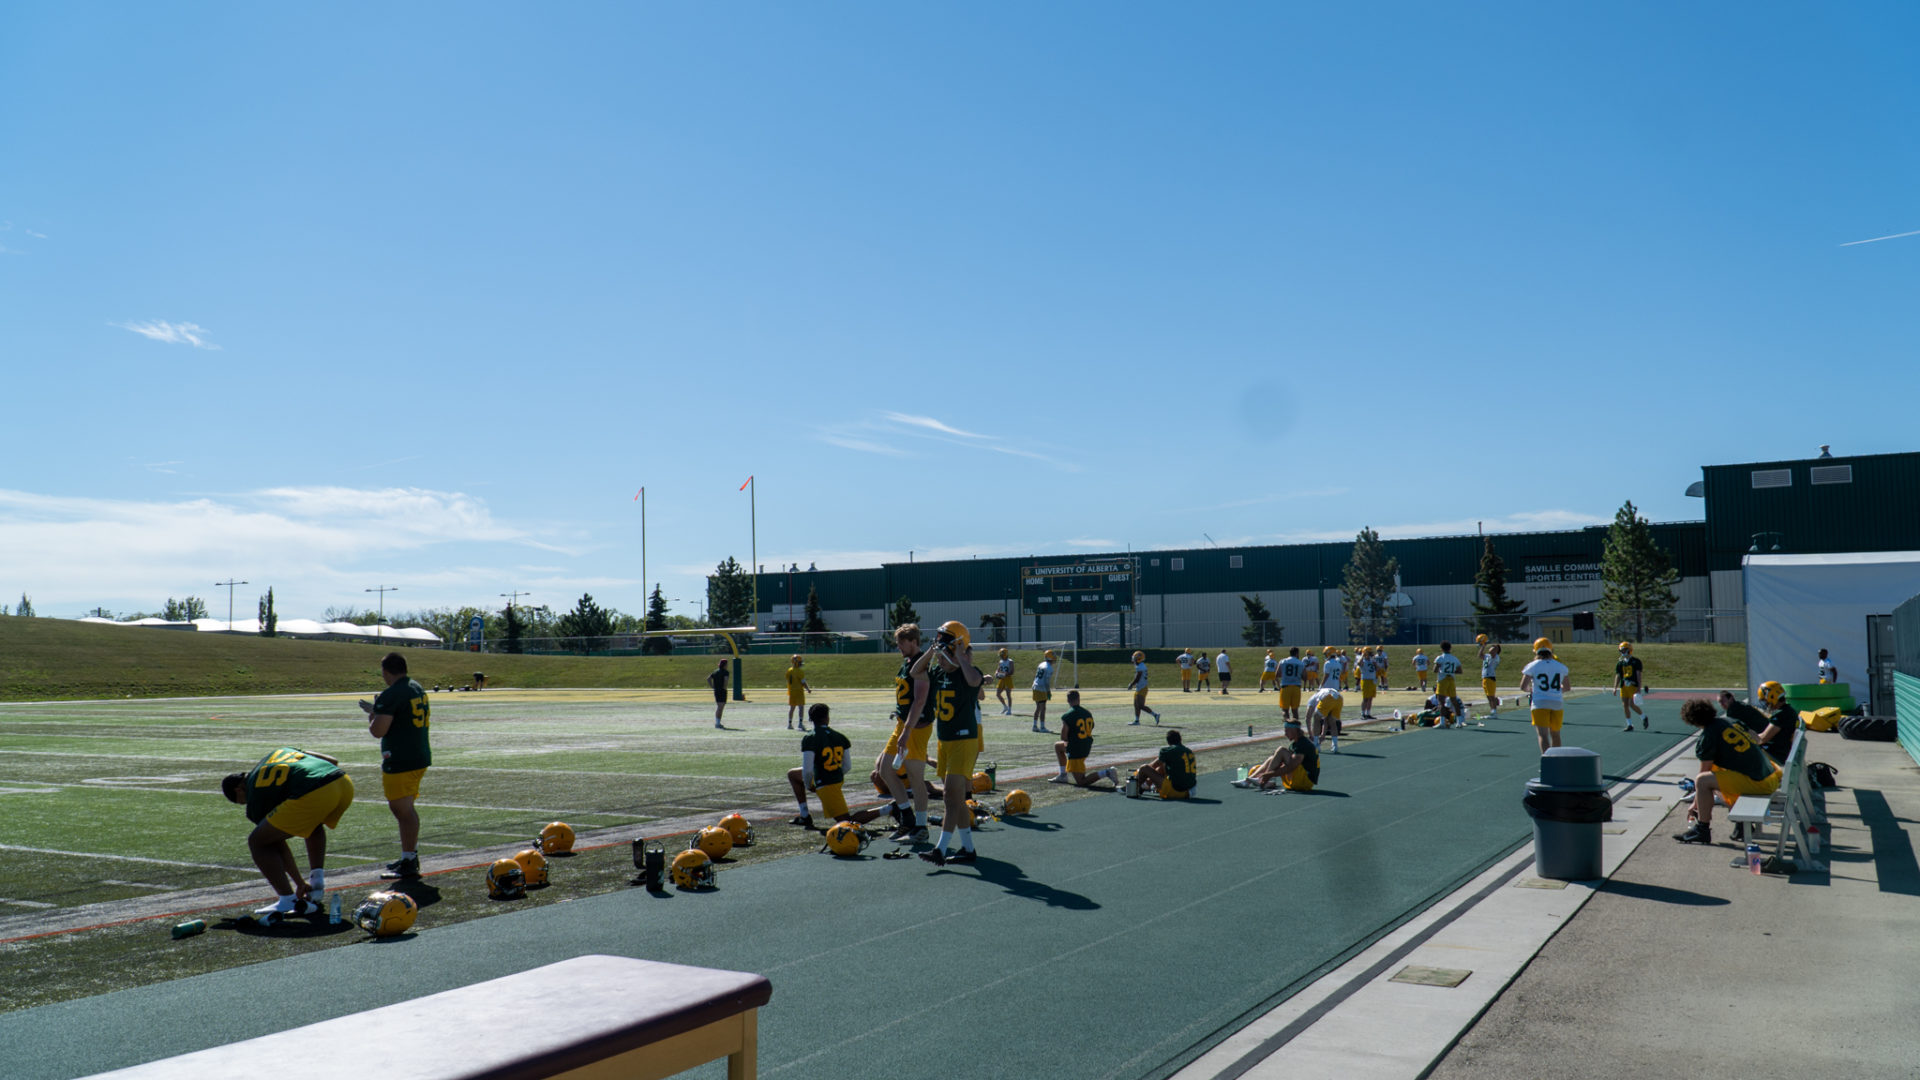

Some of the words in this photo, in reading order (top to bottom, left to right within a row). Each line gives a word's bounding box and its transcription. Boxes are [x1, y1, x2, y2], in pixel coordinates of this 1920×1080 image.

[1035, 566, 1074, 575] UNIVERSITY
[1076, 565, 1086, 573] OF
[1087, 564, 1119, 573] ALBERTA
[1524, 564, 1561, 573] SAVILLE
[1025, 577, 1044, 585] HOME
[1108, 574, 1130, 582] GUEST
[1525, 574, 1561, 582] SPORTS
[1564, 572, 1601, 581] CENTRE
[1285, 663, 1299, 677] 81
[1444, 662, 1455, 674] 21
[1537, 673, 1561, 692] 34
[896, 677, 911, 706] 2
